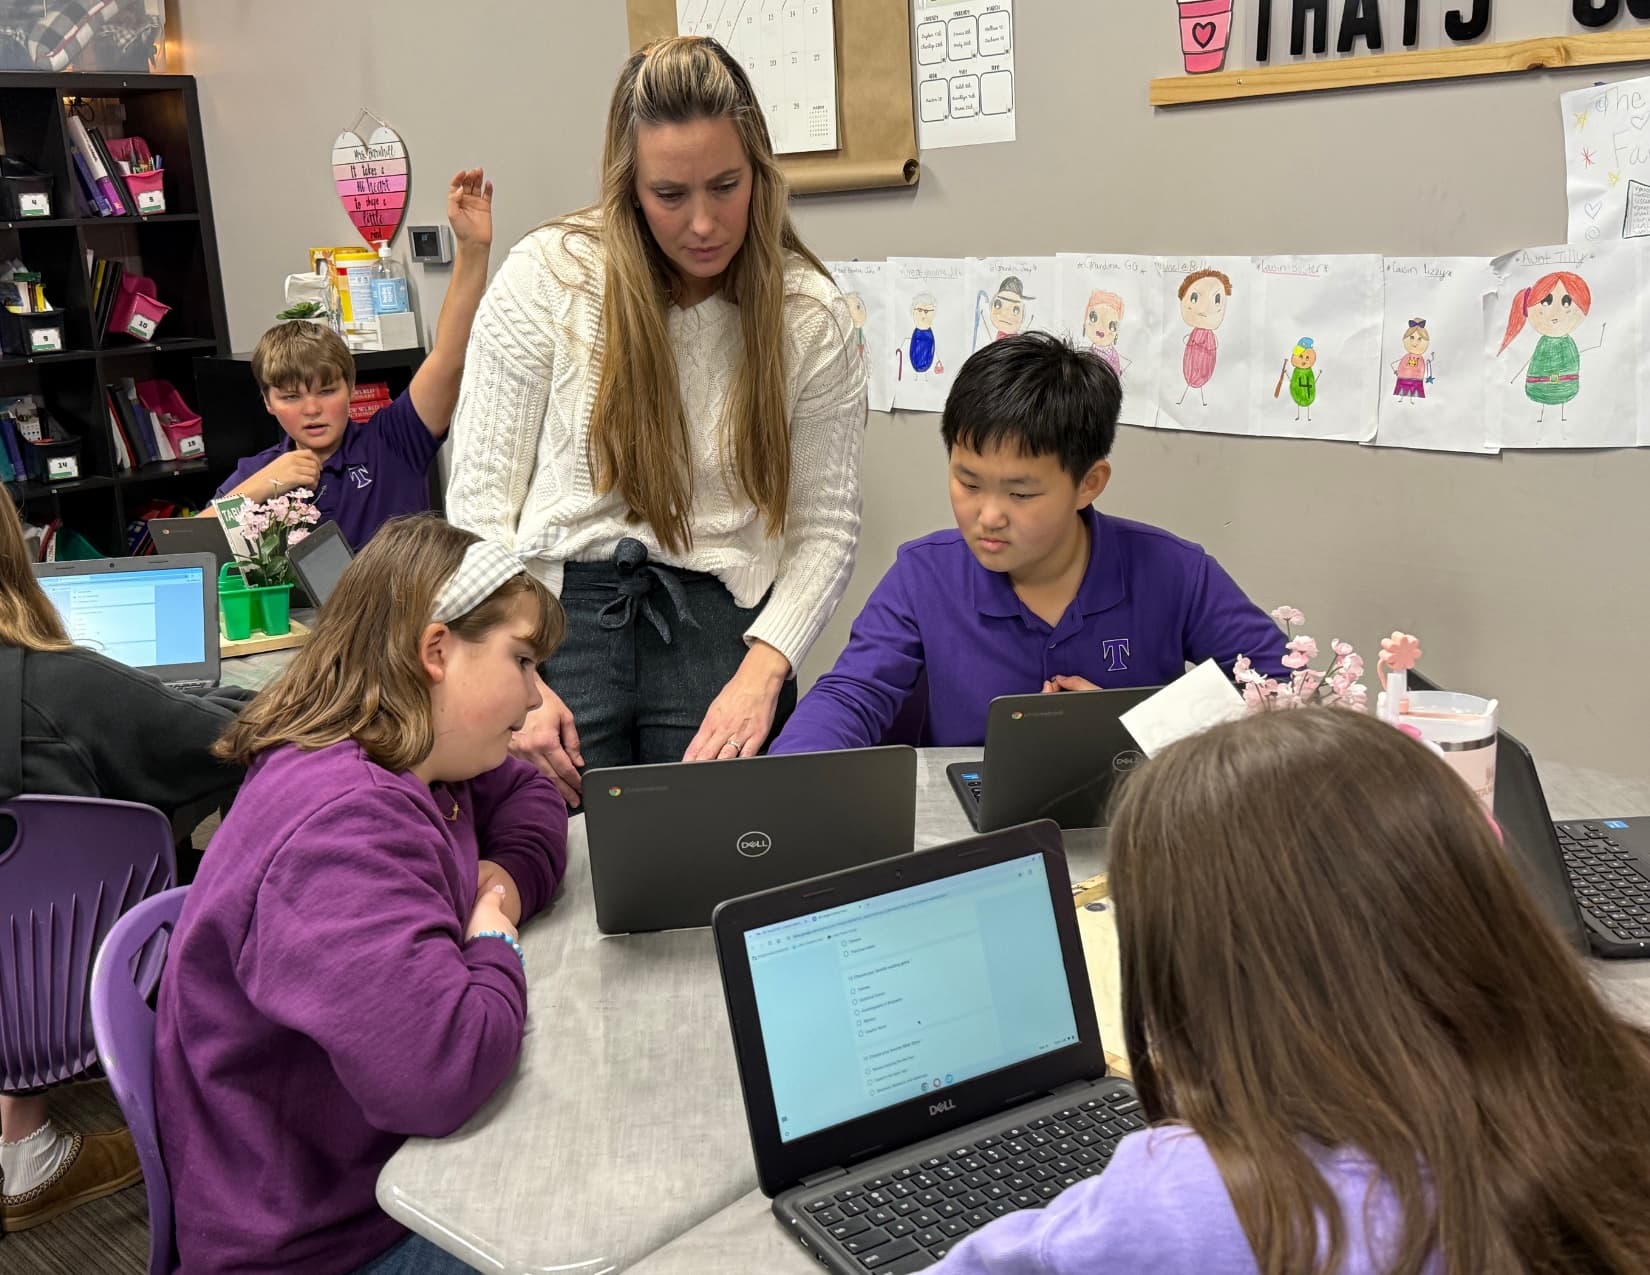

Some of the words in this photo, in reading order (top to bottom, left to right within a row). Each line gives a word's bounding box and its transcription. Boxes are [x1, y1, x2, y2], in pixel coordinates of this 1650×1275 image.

[1592, 86, 1647, 116] The
[361, 163, 378, 177] takes
[138, 320, 148, 329] 10
[1298, 375, 1312, 399] 4
[57, 461, 68, 469] 14
[348, 464, 372, 489] T
[1102, 638, 1130, 672] T
[741, 840, 768, 849] DELL
[929, 1099, 956, 1116] DELL
